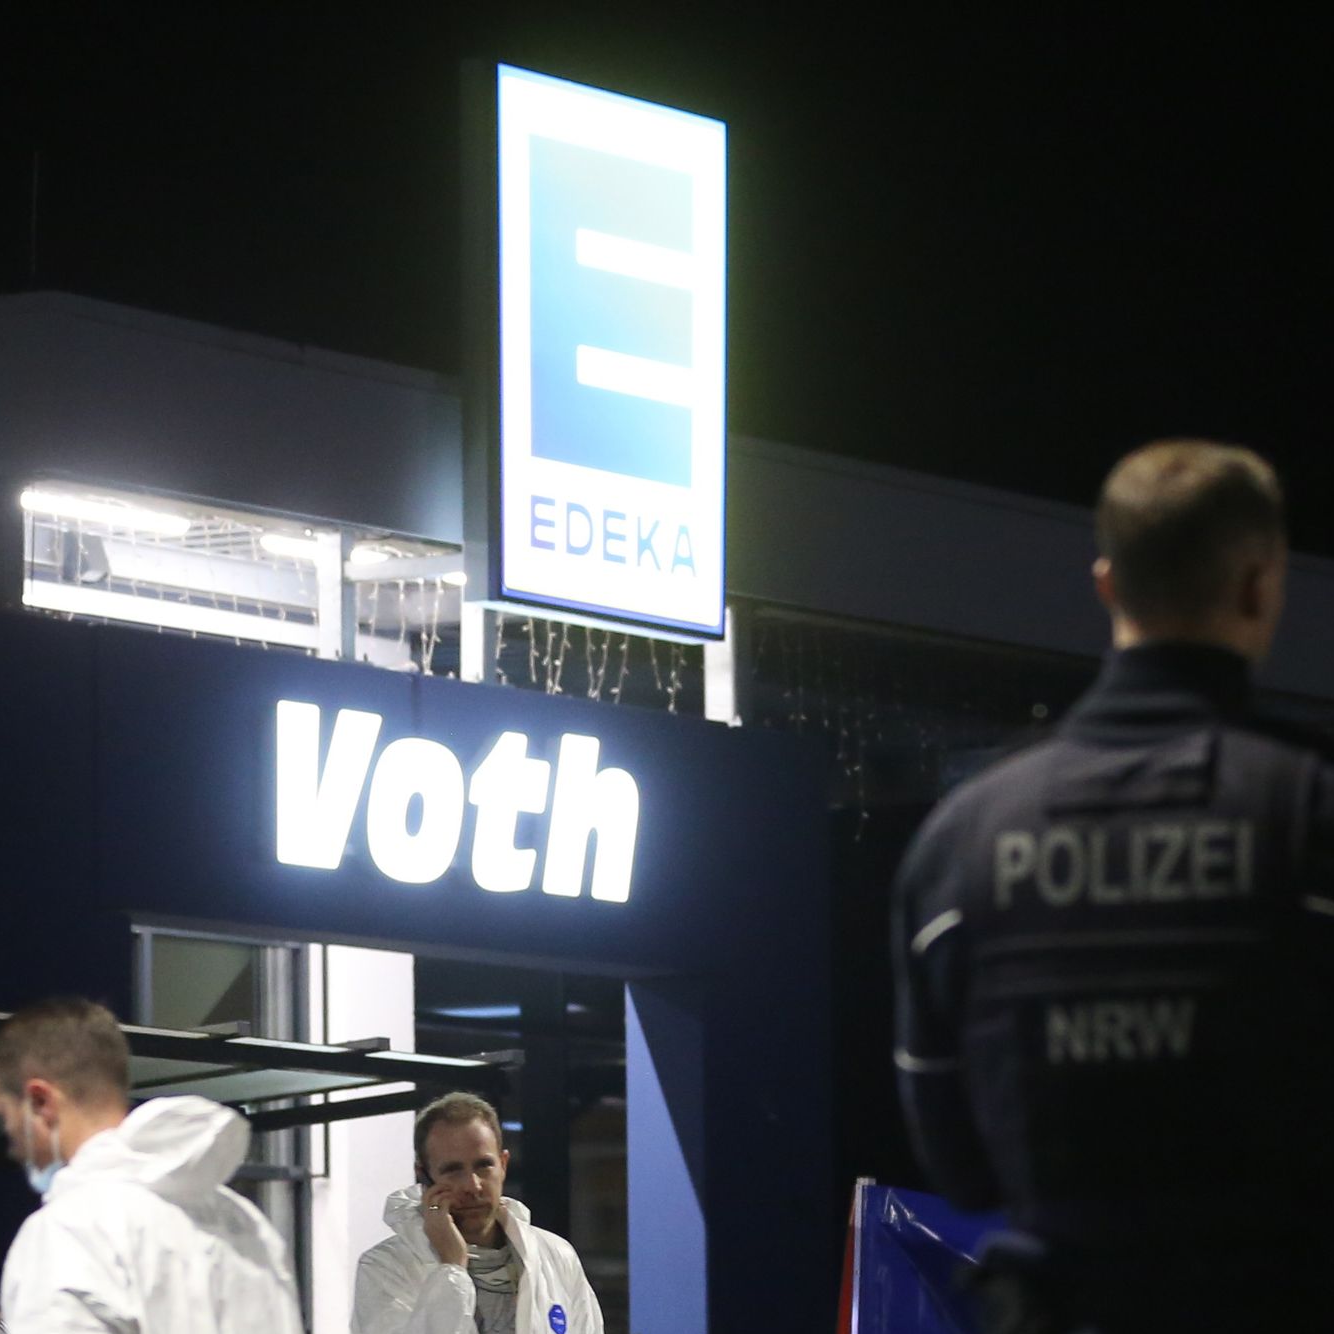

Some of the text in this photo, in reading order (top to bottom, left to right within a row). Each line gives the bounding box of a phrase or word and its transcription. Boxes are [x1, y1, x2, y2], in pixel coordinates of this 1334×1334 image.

[530, 494, 696, 577] EDEKA
[276, 699, 640, 903] Voth
[993, 820, 1256, 912] POLIZEI
[1044, 999, 1197, 1065] NRW
